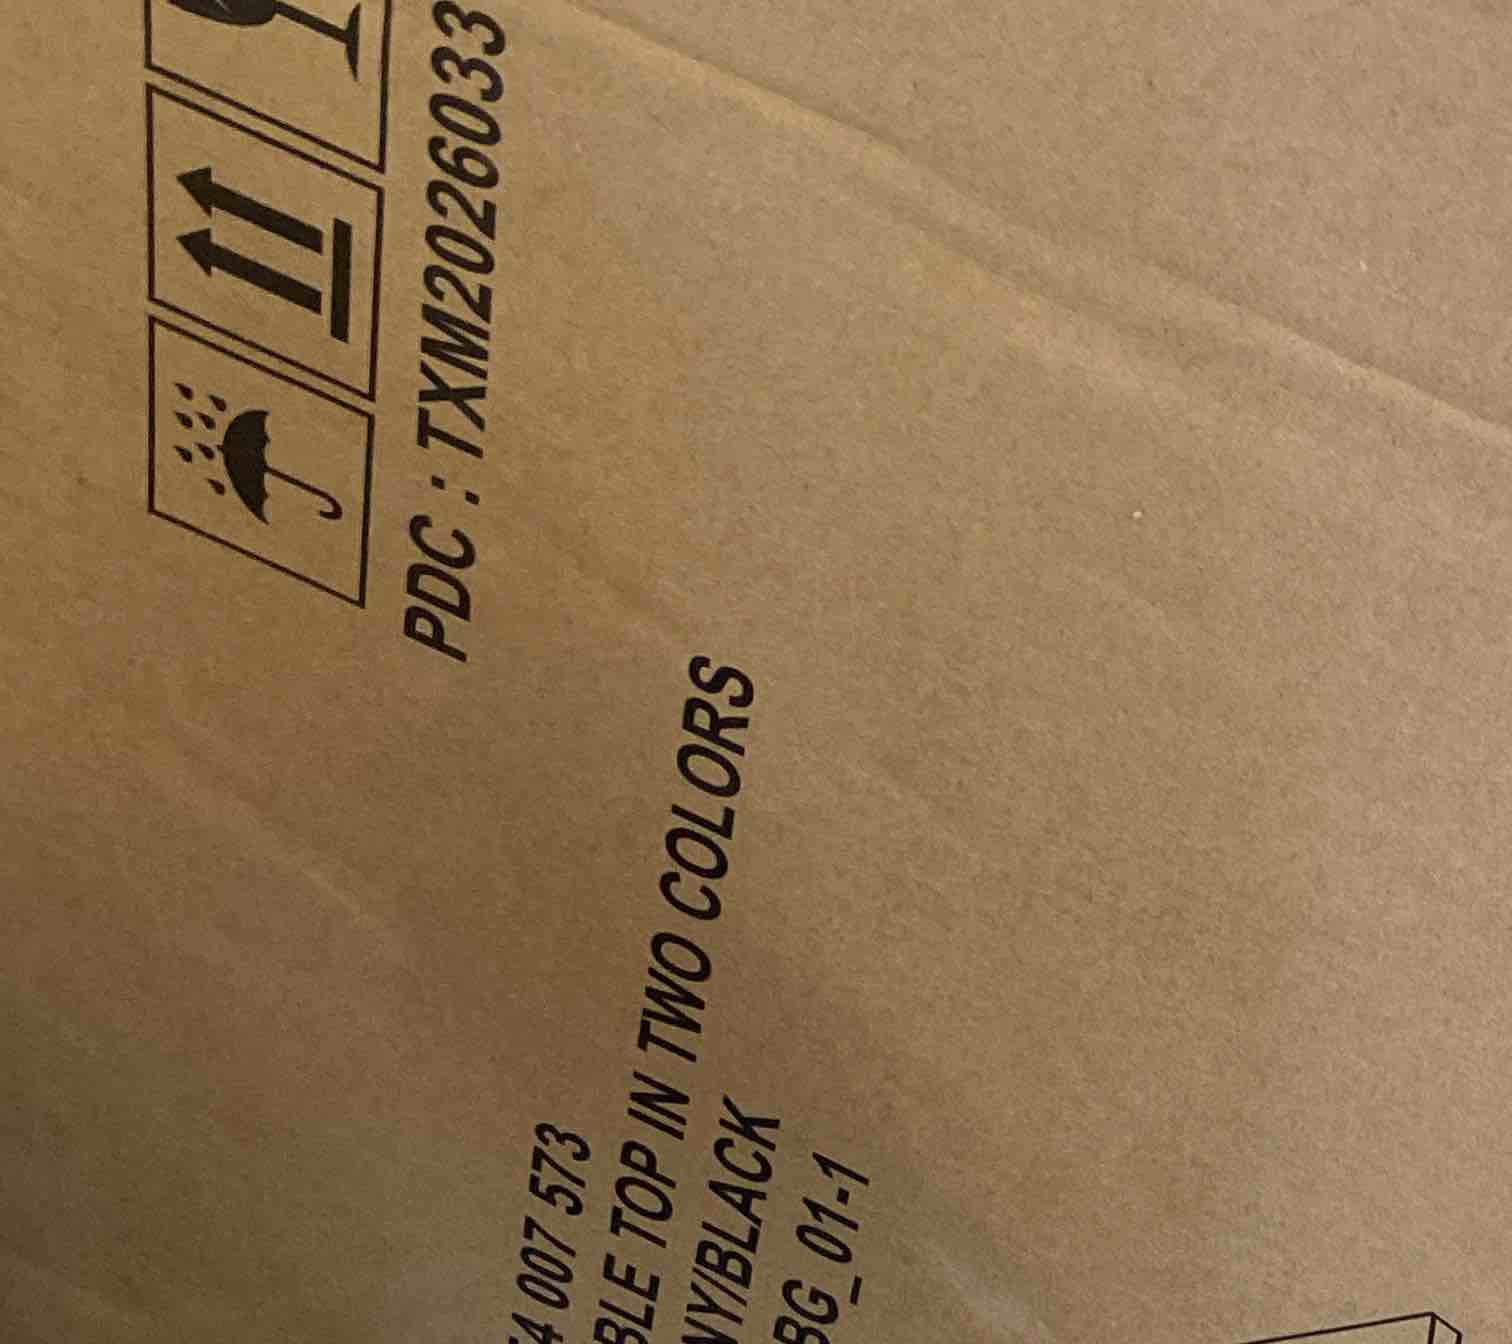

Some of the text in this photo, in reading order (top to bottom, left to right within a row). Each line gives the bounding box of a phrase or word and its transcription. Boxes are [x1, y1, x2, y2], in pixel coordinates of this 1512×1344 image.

[432, 474, 480, 504] :
[404, 515, 479, 663] PDC
[660, 656, 754, 920] COLORS
[637, 932, 712, 1063] TWO
[627, 1071, 691, 1141] IN
[528, 1123, 591, 1216] 573
[610, 1141, 677, 1248] TOP
[516, 1216, 577, 1309] 007
